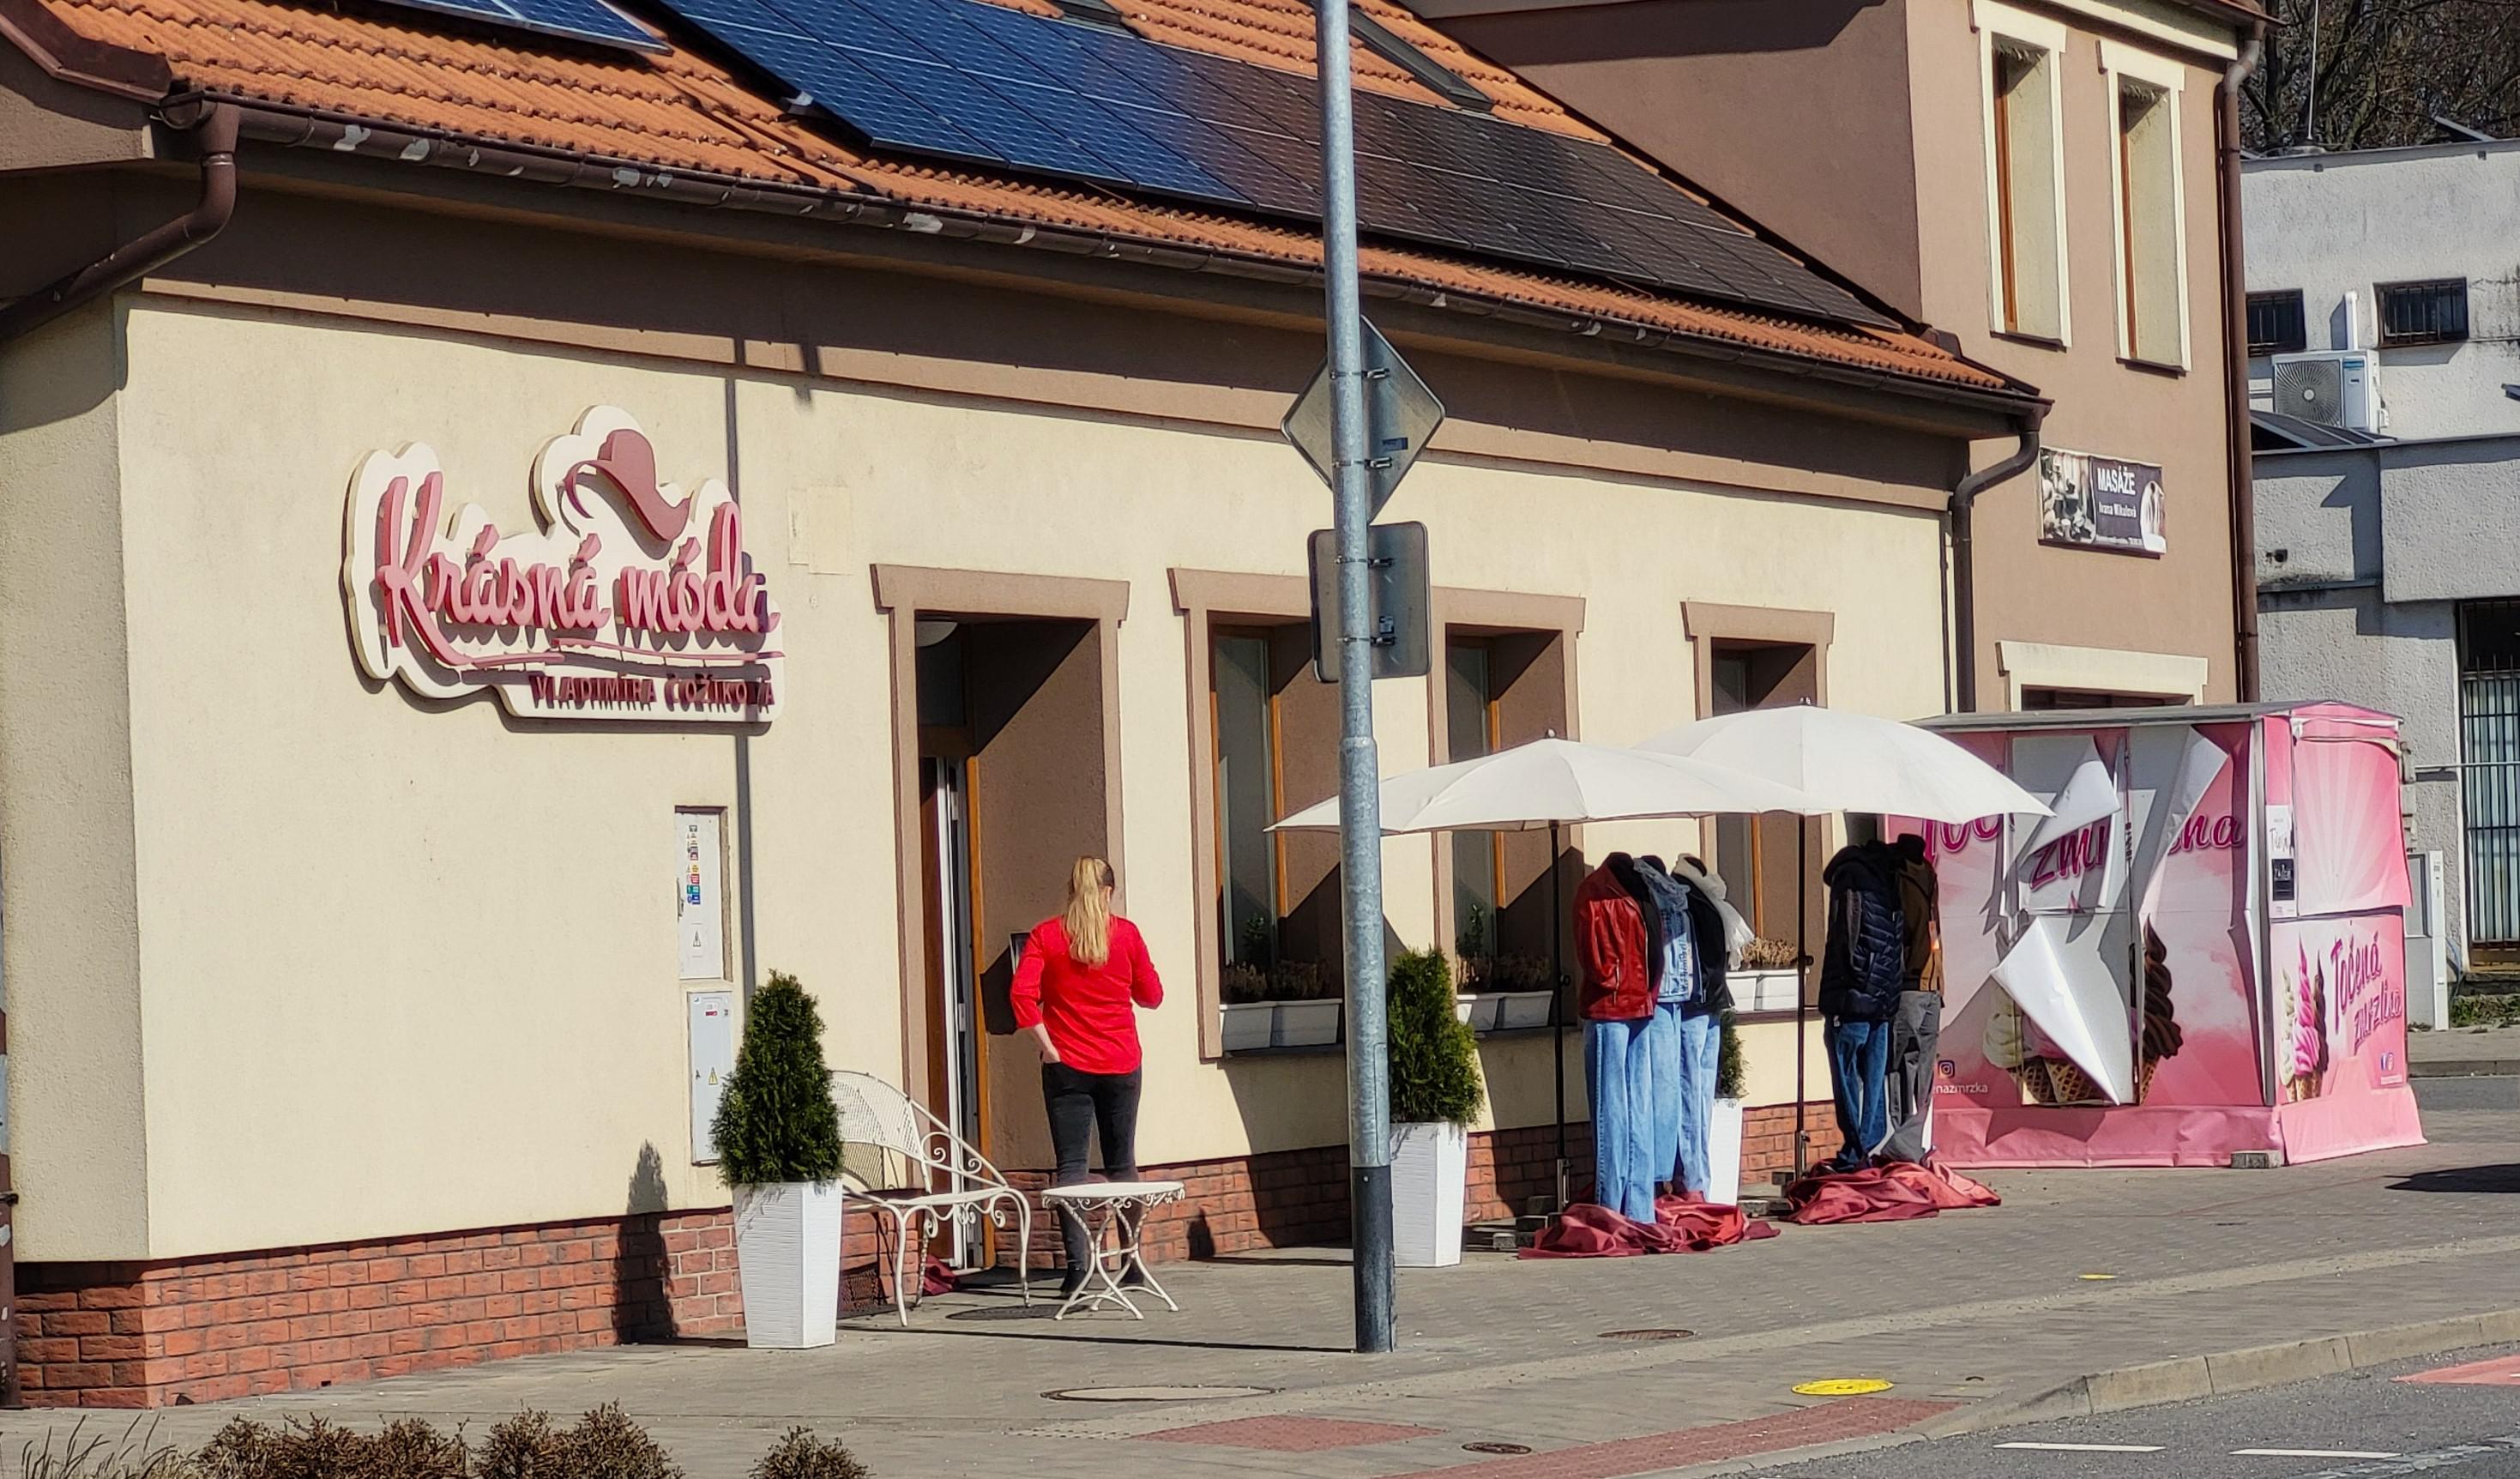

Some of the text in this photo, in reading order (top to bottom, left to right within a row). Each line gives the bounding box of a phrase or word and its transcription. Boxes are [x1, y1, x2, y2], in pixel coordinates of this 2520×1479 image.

[2097, 465, 2136, 495] MASÁŽE
[376, 471, 782, 667] Krásná móda
[2330, 931, 2382, 1035] Točená
